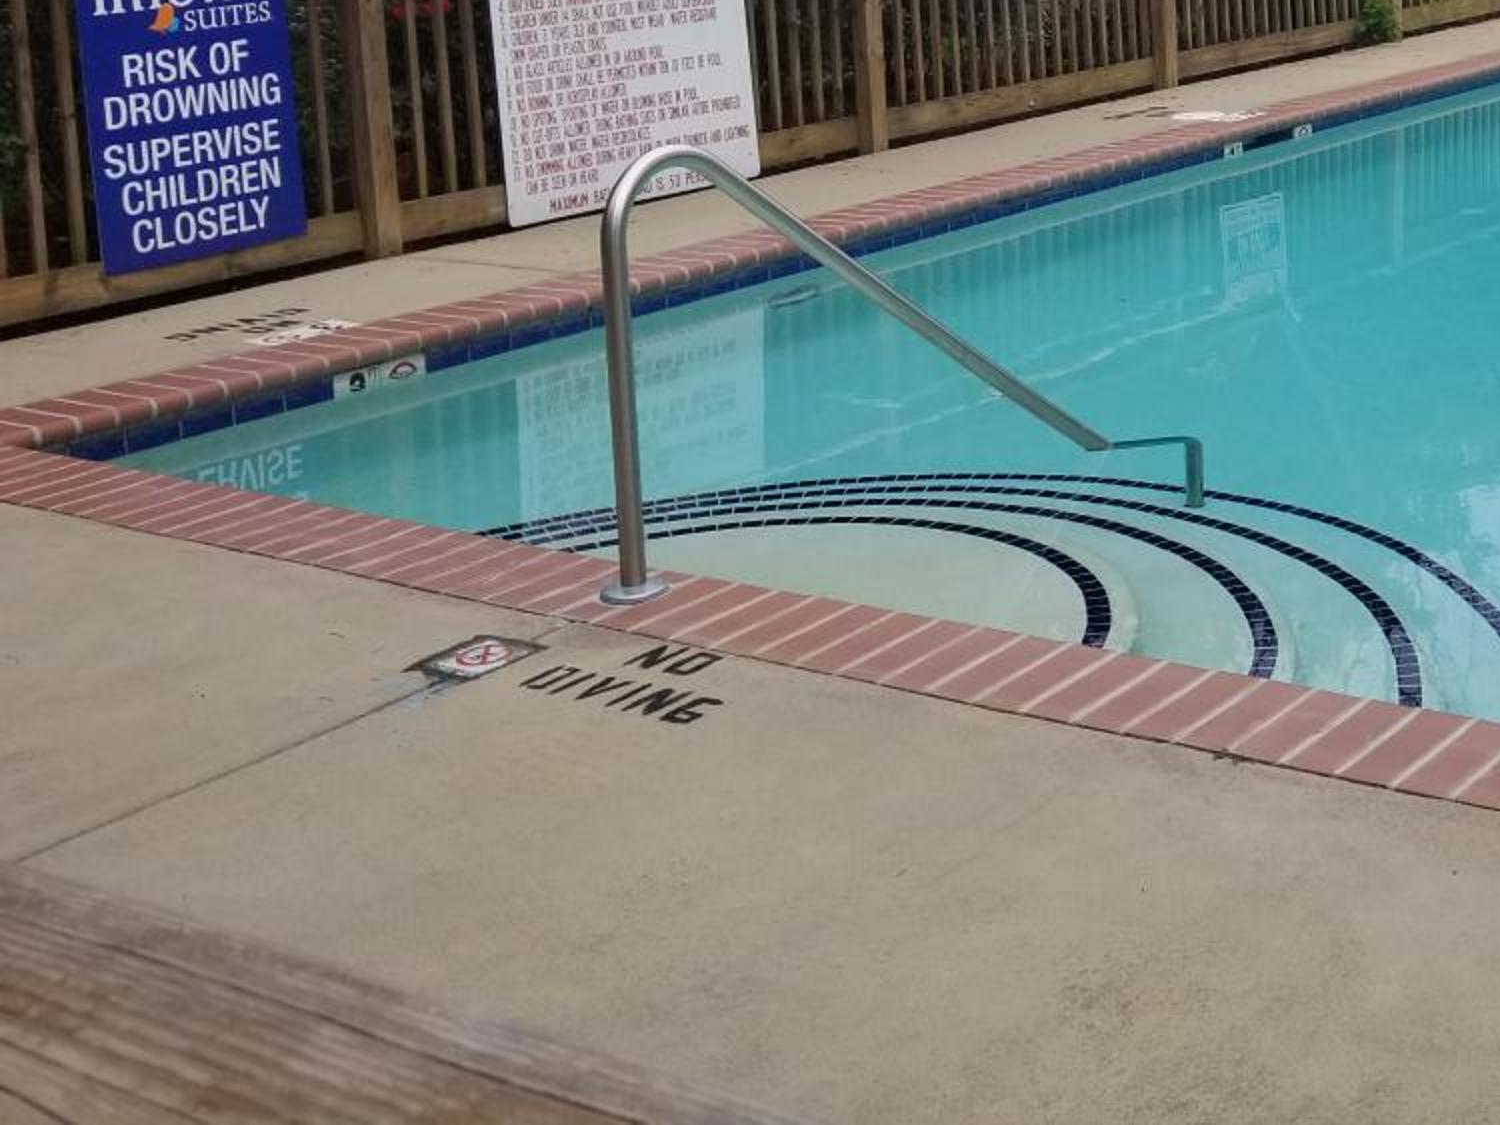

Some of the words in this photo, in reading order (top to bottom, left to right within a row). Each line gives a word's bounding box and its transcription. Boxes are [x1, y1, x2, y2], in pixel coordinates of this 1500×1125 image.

[184, 0, 272, 33] SUITES
[122, 49, 200, 88] RISK
[209, 38, 250, 76] OF
[103, 73, 282, 131] DROWNING
[103, 118, 282, 180] SUPERVISE
[121, 156, 282, 217] CHILDREN
[131, 196, 271, 254] CLOSELY
[623, 644, 724, 677] NO
[518, 664, 725, 725] DIVING
